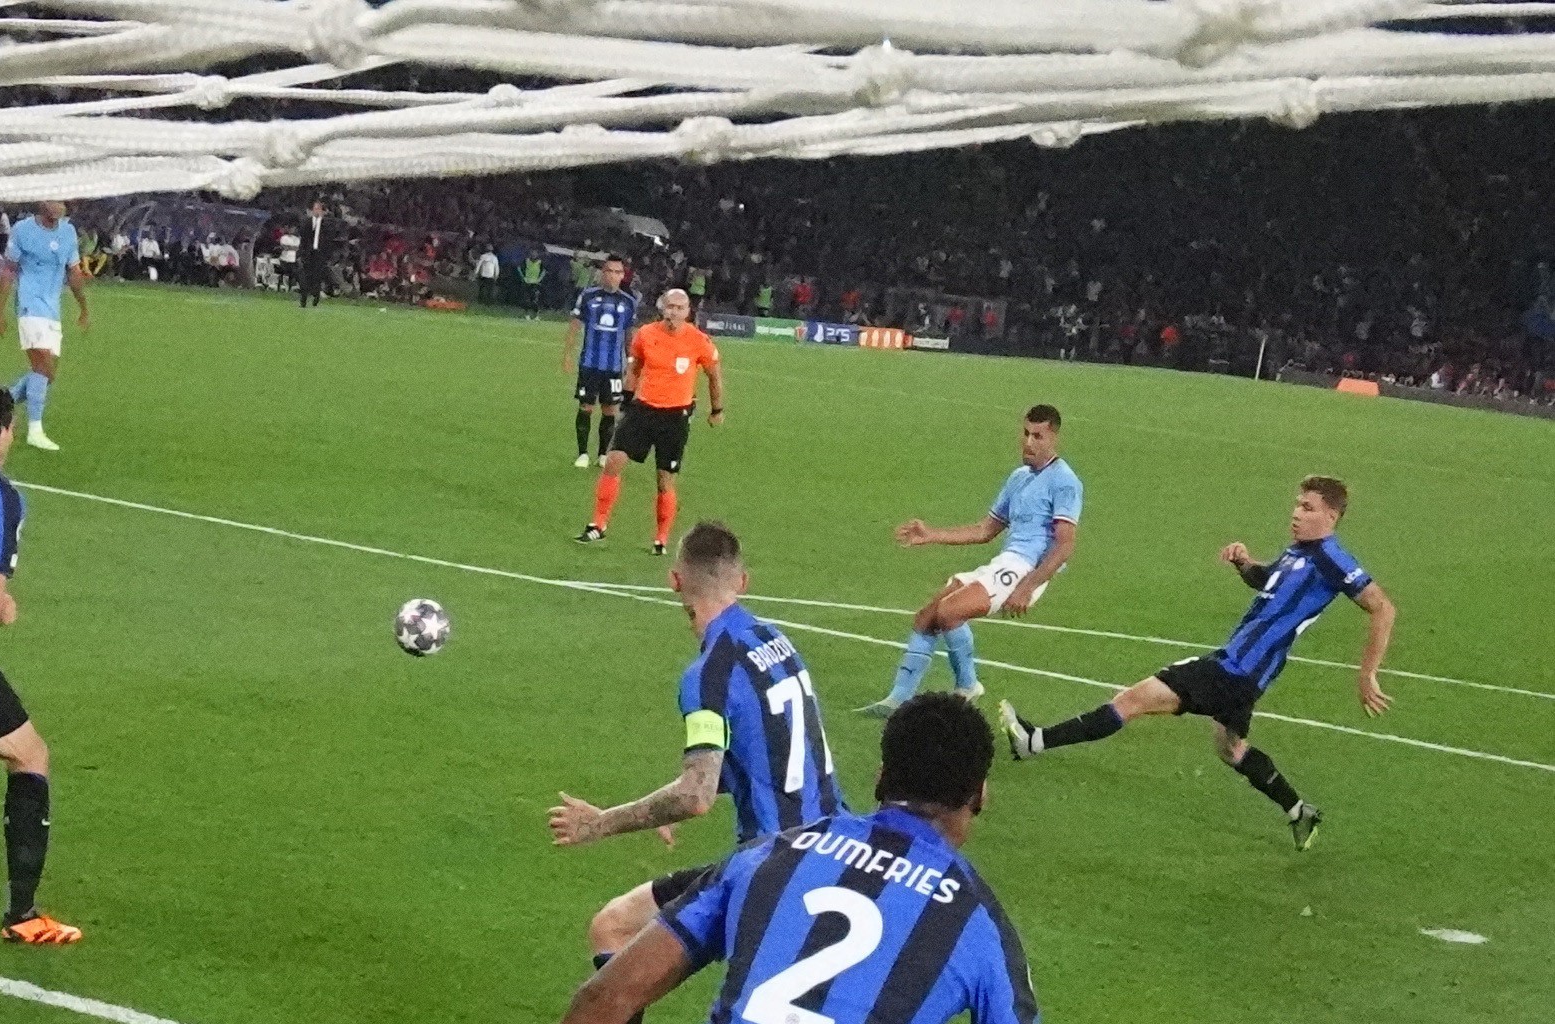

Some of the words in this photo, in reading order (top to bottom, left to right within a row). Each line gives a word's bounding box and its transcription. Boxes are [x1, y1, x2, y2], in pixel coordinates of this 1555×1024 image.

[609, 378, 623, 393] 10
[747, 634, 797, 672] BROZO
[791, 832, 962, 904] DUMFRIES
